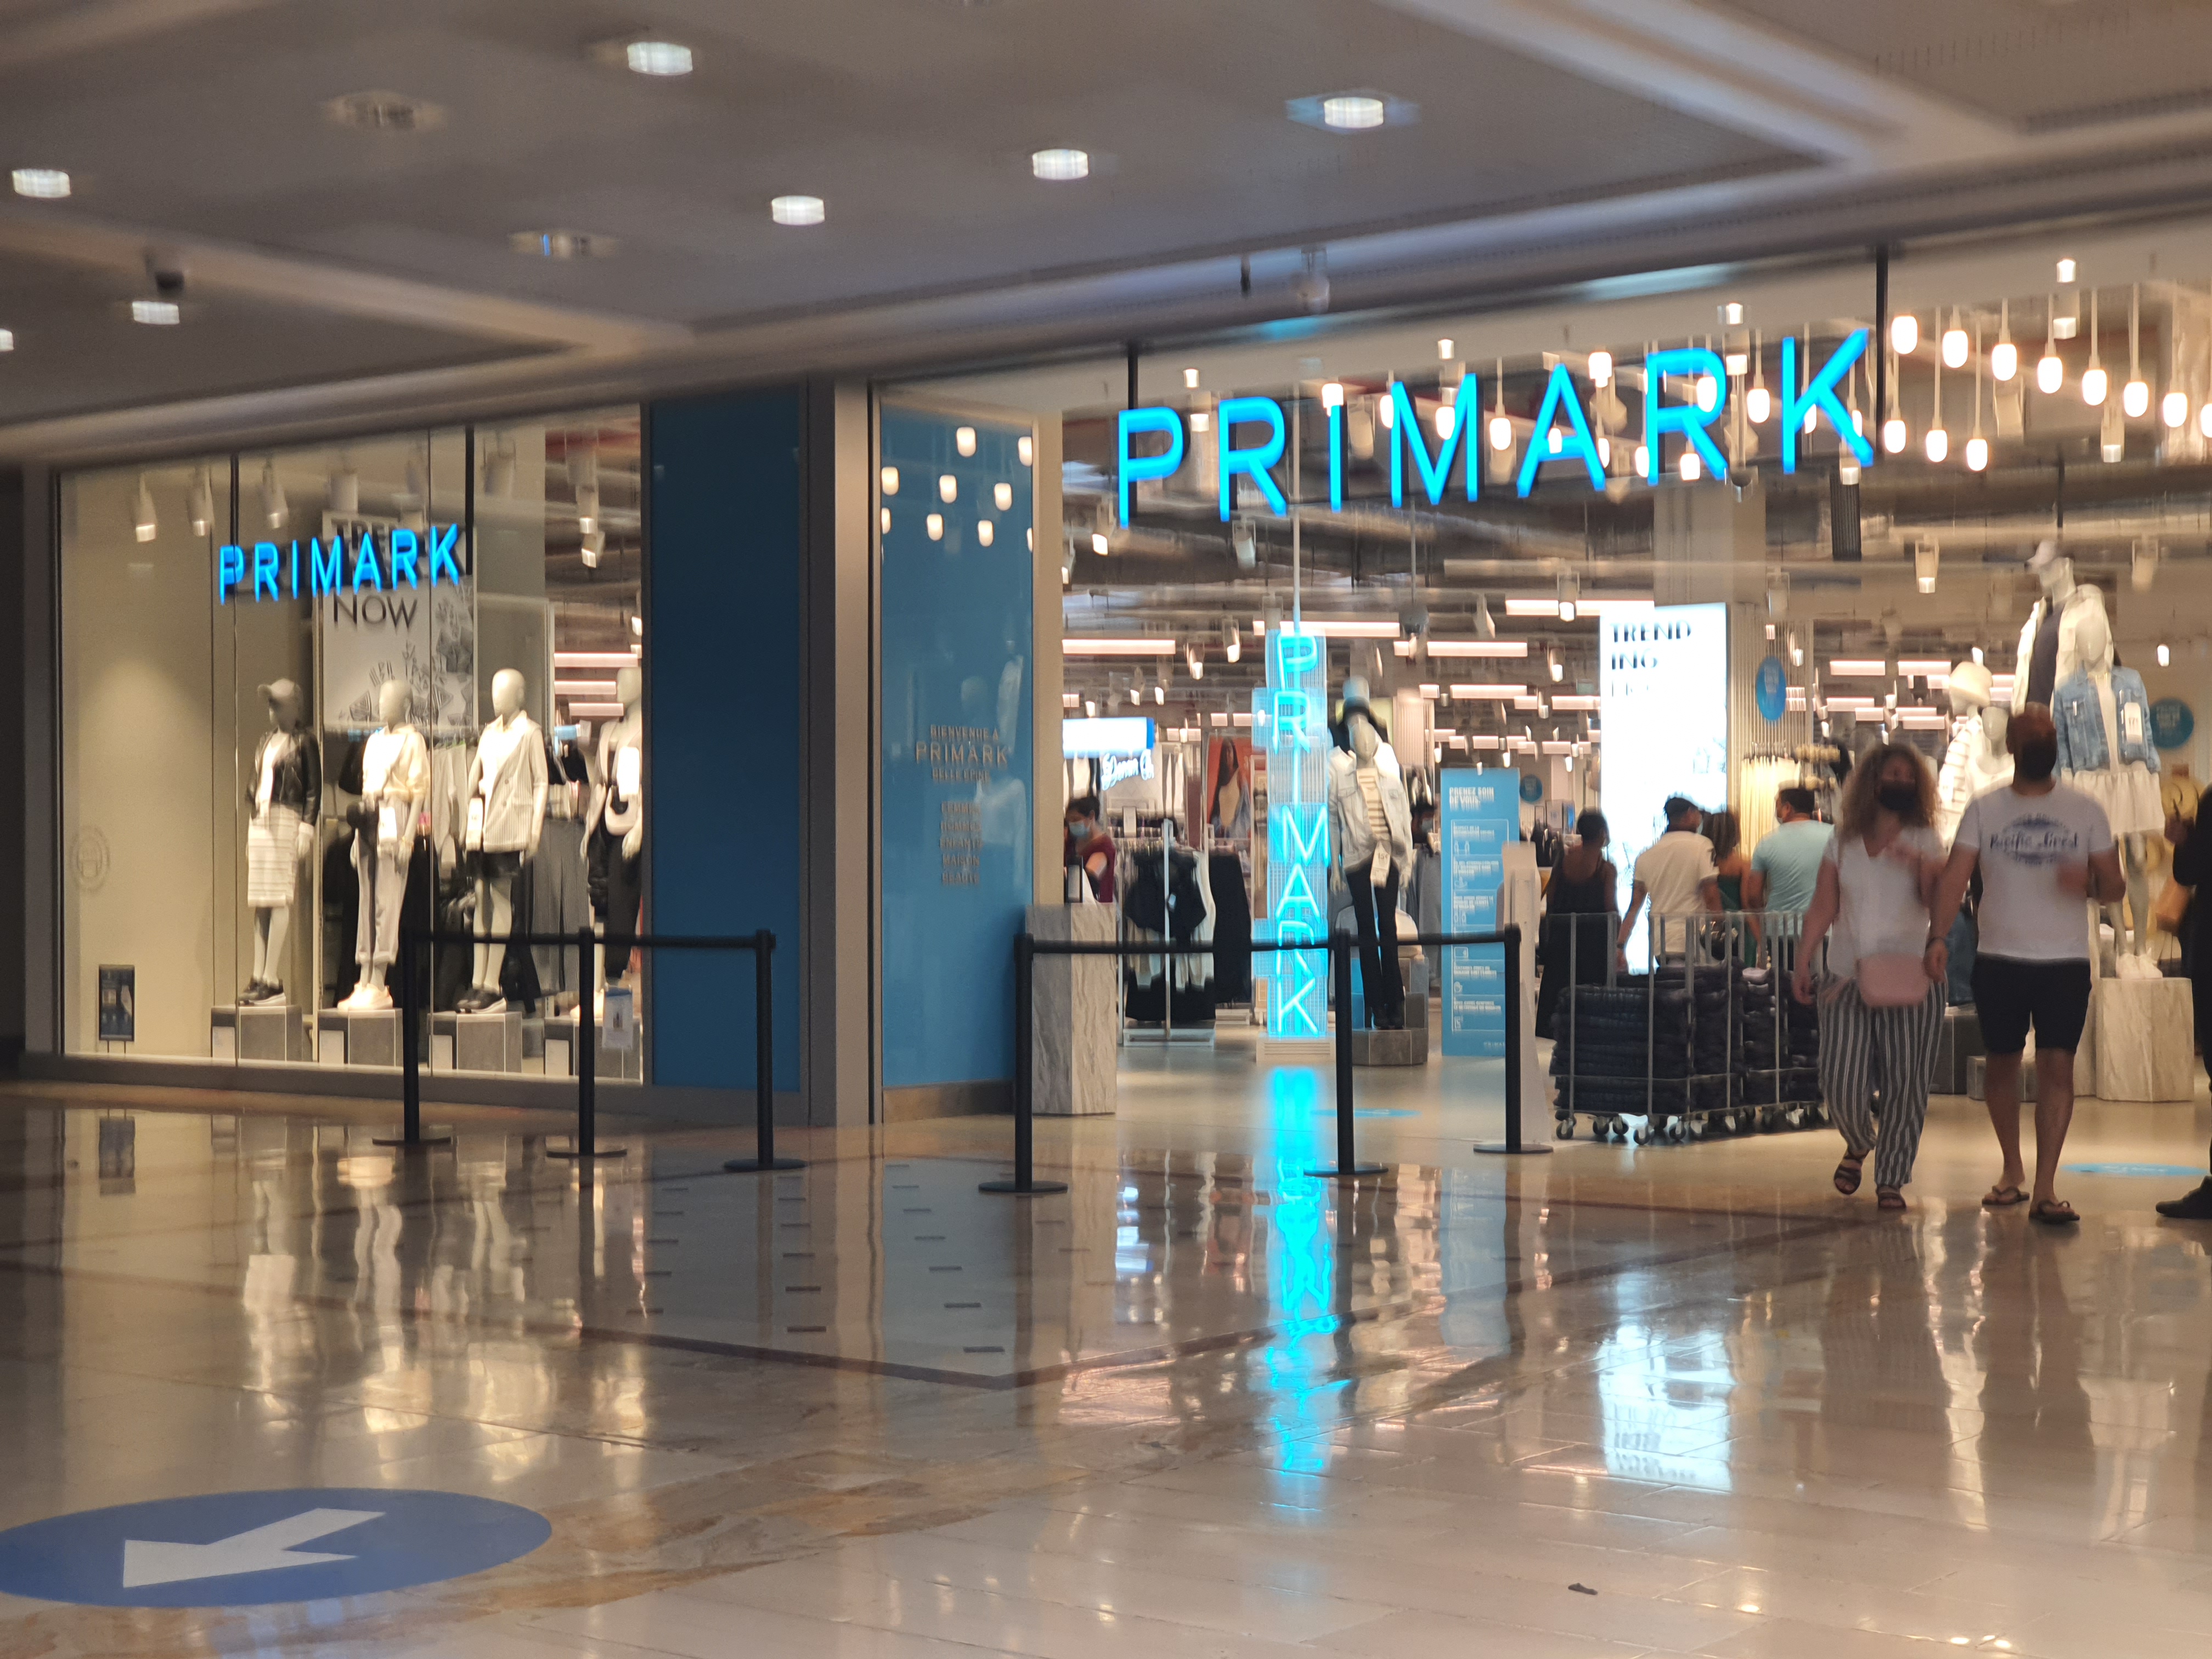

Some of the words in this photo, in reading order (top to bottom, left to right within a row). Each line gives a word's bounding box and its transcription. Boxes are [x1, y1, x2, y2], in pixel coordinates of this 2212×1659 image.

[1118, 329, 1874, 528] PRIMARK
[219, 523, 459, 605] PRIMARK
[334, 594, 417, 628] NOW
[1610, 620, 1691, 642] TREND
[916, 741, 1008, 766] PRIMARK
[1273, 633, 1331, 1037] PRIMARK
